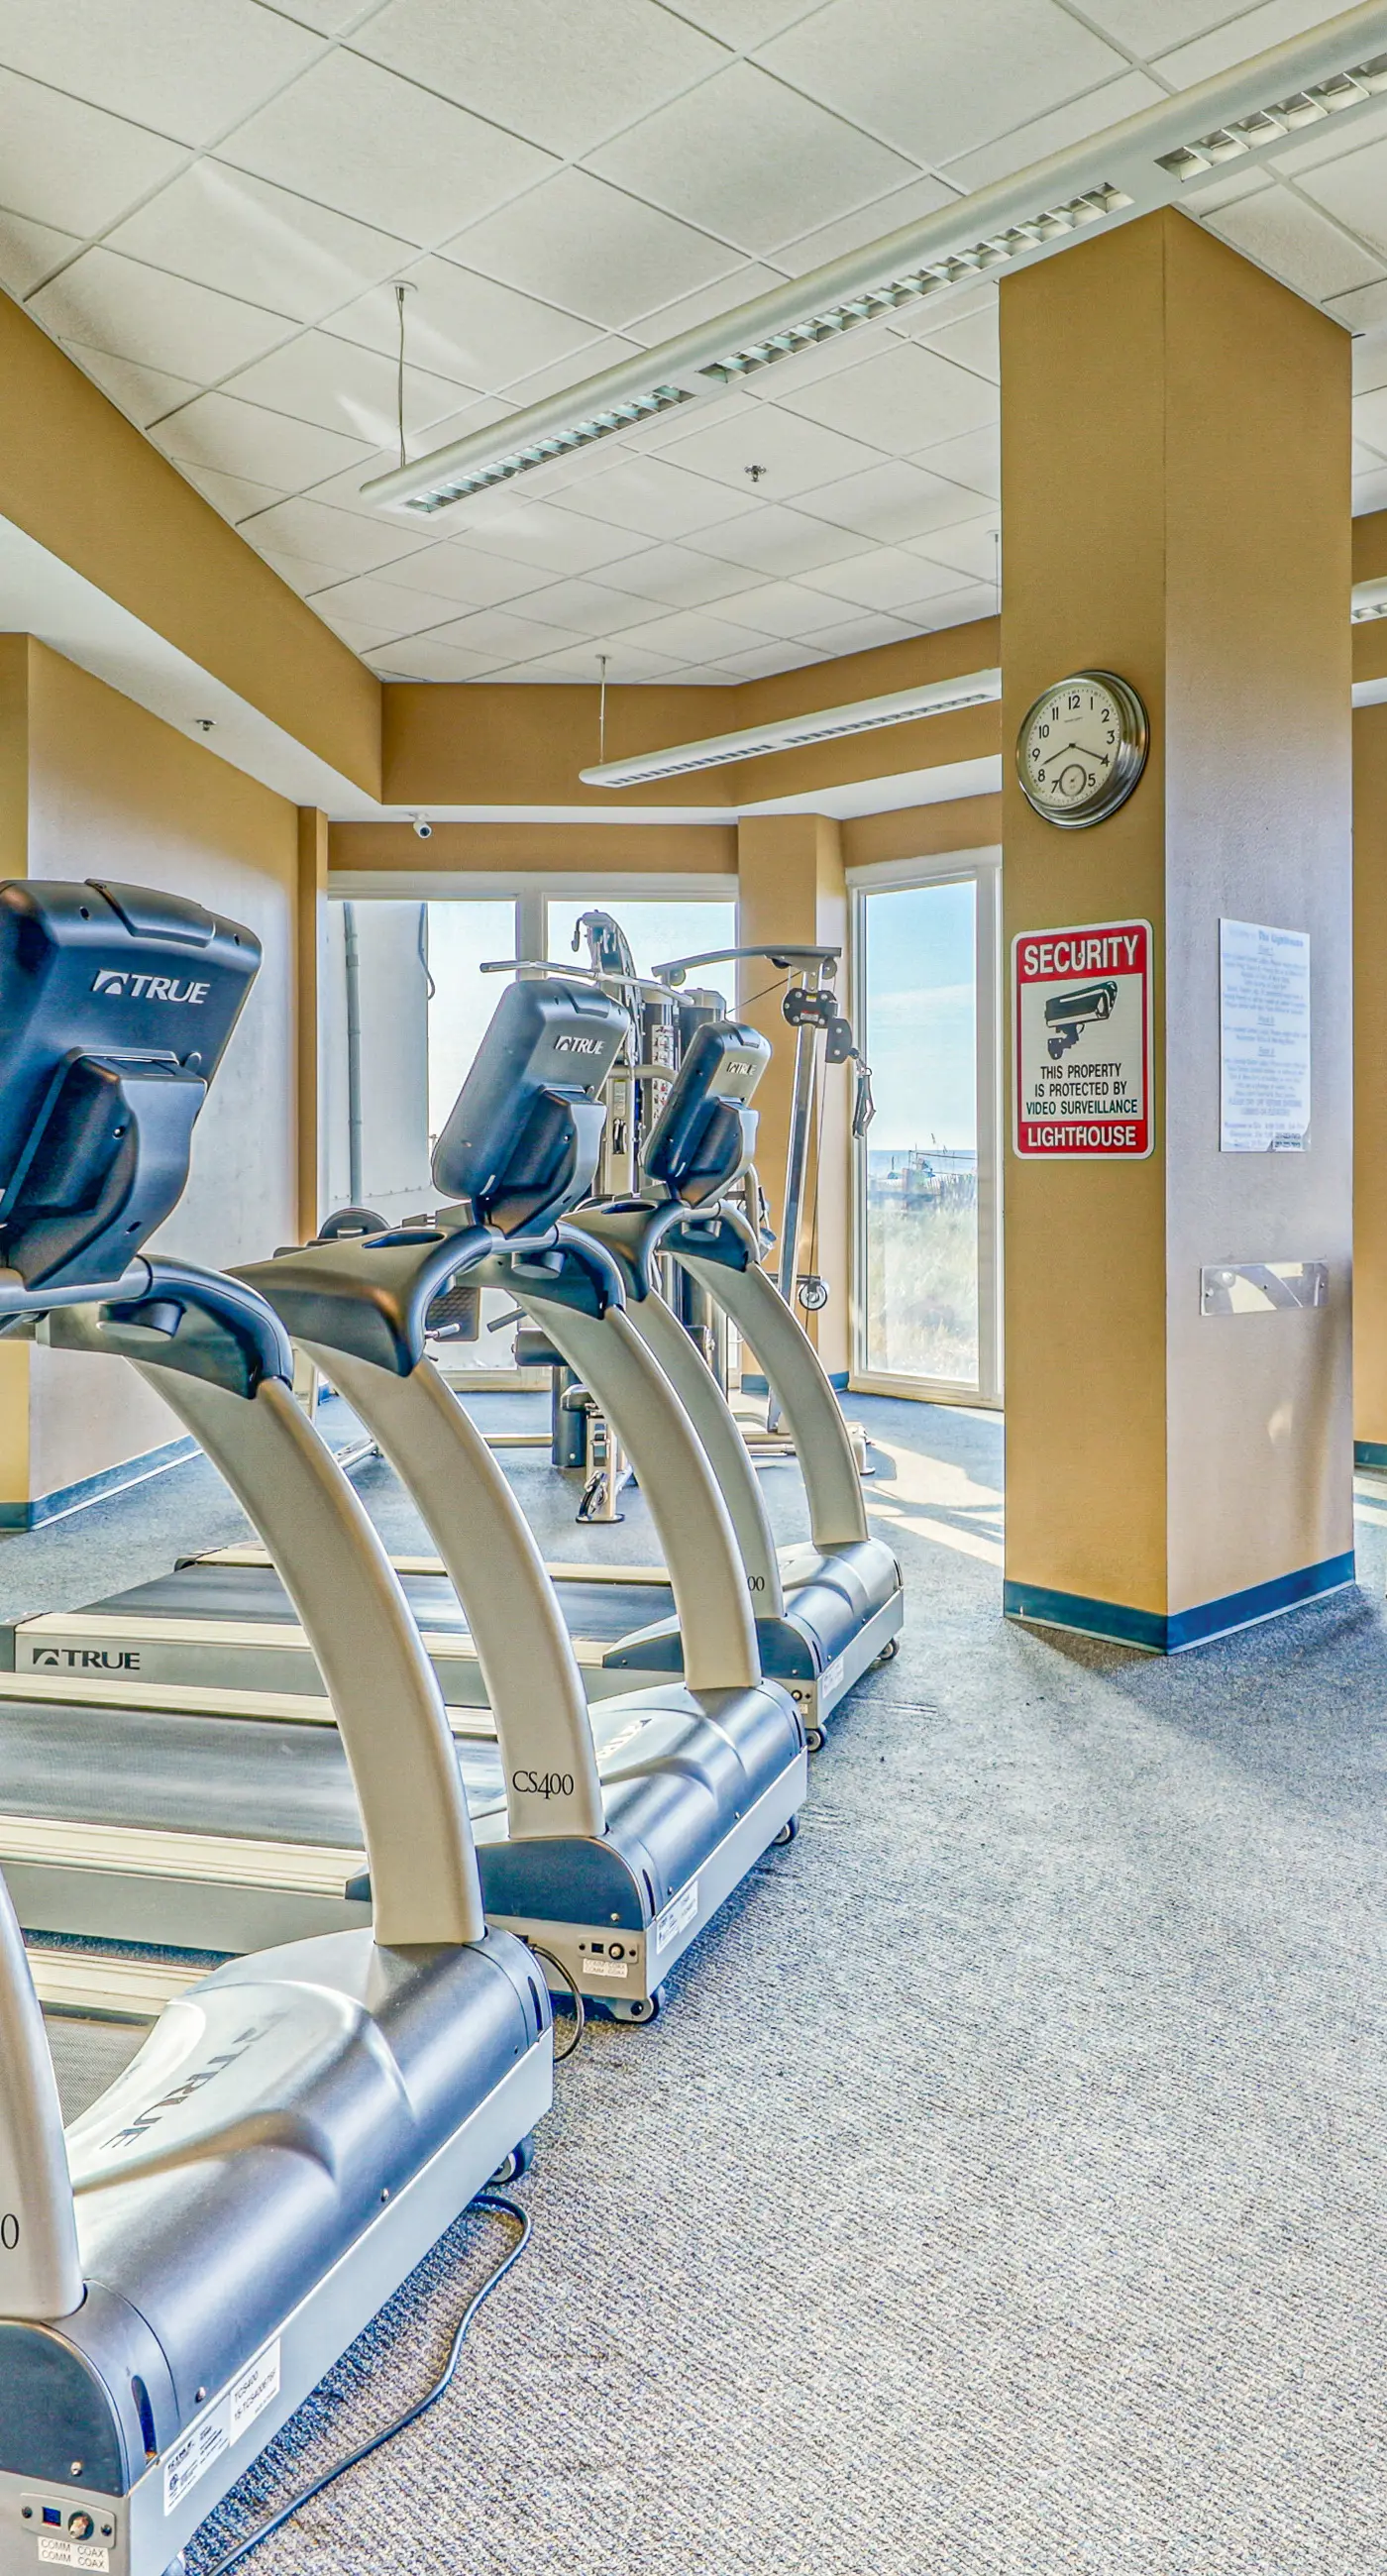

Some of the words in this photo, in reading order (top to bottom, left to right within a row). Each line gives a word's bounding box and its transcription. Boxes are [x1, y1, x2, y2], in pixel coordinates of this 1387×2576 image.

[1068, 695, 1081, 710] 12
[1051, 706, 1059, 721] 11
[1101, 708, 1110, 723] 2
[1038, 724, 1050, 739] 10
[1107, 729, 1116, 745] 3
[1031, 747, 1040, 762] 9
[1100, 753, 1111, 767] 4
[1037, 768, 1046, 783] 8
[1088, 773, 1097, 787] 5
[1050, 779, 1060, 794] 7
[1023, 934, 1139, 976] SECURITY
[130, 974, 211, 1004] TRUE
[571, 1036, 605, 1055] TRUE
[1040, 1065, 1063, 1080] THIS
[1067, 1062, 1122, 1079] PROPERTY
[1034, 1083, 1045, 1098] IS
[1049, 1081, 1110, 1097] PROTECTED
[1113, 1081, 1127, 1096] BY
[1025, 1101, 1057, 1116] VIDEO
[1060, 1099, 1138, 1115] SURVEILLANCE
[1027, 1125, 1136, 1147] LIGHTHOUSE
[60, 1649, 141, 1670] TRUE
[512, 1770, 575, 1800] CS400
[99, 2044, 253, 2150] TRUE
[41, 2538, 71, 2553] COMM
[77, 2545, 104, 2558] COAX
[42, 2549, 71, 2564] COMM
[77, 2556, 105, 2569] COAX
